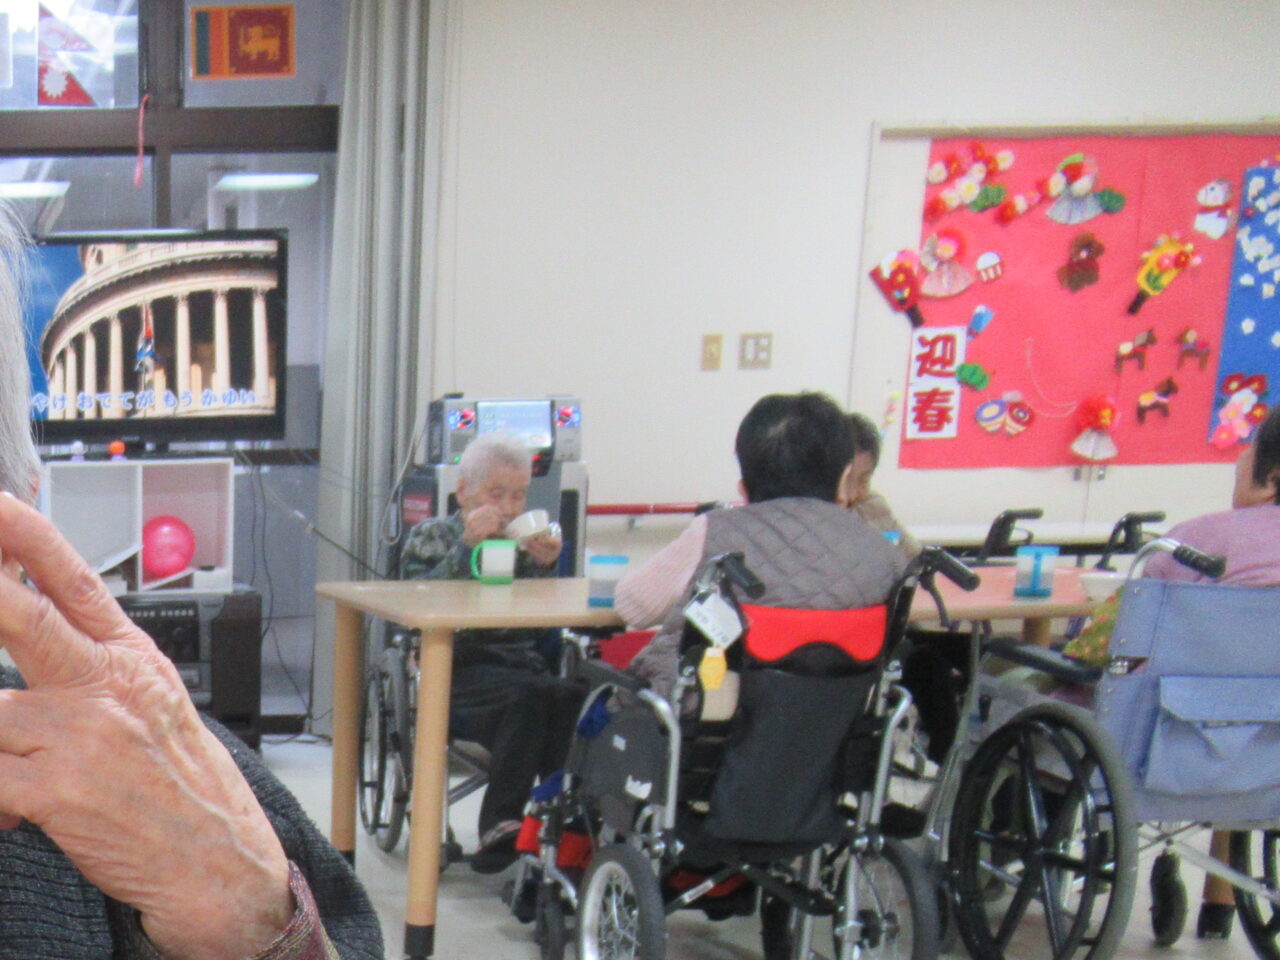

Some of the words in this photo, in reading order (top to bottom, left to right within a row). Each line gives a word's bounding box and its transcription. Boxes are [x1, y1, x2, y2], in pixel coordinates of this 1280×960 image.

[163, 389, 192, 408] もう
[201, 388, 256, 406] かゆい
[911, 333, 957, 432] 迎春
